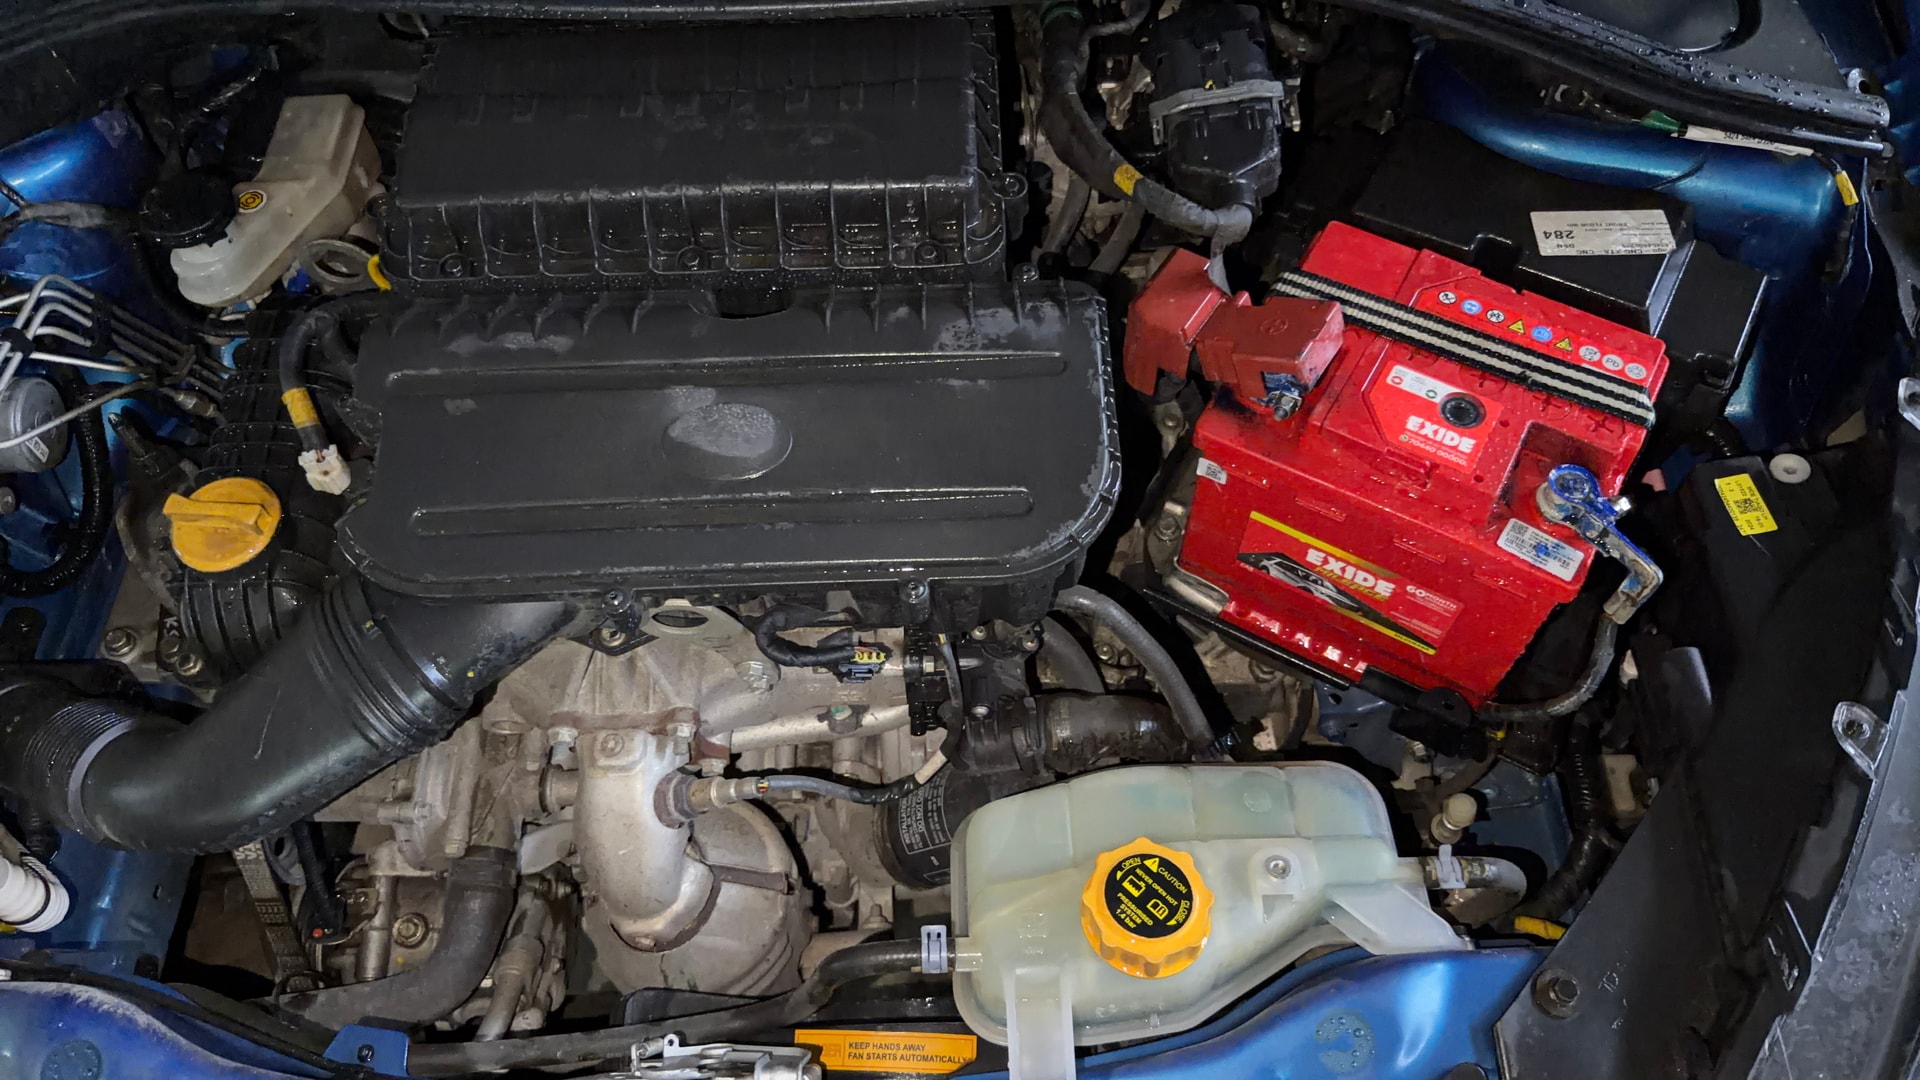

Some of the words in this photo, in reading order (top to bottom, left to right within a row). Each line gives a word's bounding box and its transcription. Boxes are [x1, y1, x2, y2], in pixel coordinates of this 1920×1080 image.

[1543, 230, 1575, 240] 284
[1605, 356, 1620, 368] Pb
[1405, 415, 1476, 454] EXIDE
[1304, 548, 1396, 597] EXIDE
[1314, 566, 1390, 602] MILEAGE
[1122, 856, 1142, 869] OPEN
[1135, 868, 1154, 886] NEVER
[1152, 882, 1167, 898] OPEN
[1165, 894, 1178, 906] HOT
[1158, 867, 1188, 894] CAUTION
[1115, 908, 1126, 919] 1.4
[1124, 917, 1136, 928] bar
[1116, 892, 1154, 926] PRESSURISED
[1120, 904, 1142, 924] SYSTEM
[1174, 900, 1190, 924] CLOSE
[848, 1042, 870, 1050] KEEP
[872, 1042, 900, 1051] HANDS
[902, 1044, 926, 1052] AWAY
[848, 1052, 864, 1060] FAN
[866, 1052, 898, 1062] STARTS
[898, 1054, 968, 1065] AUTOMATICALLY
